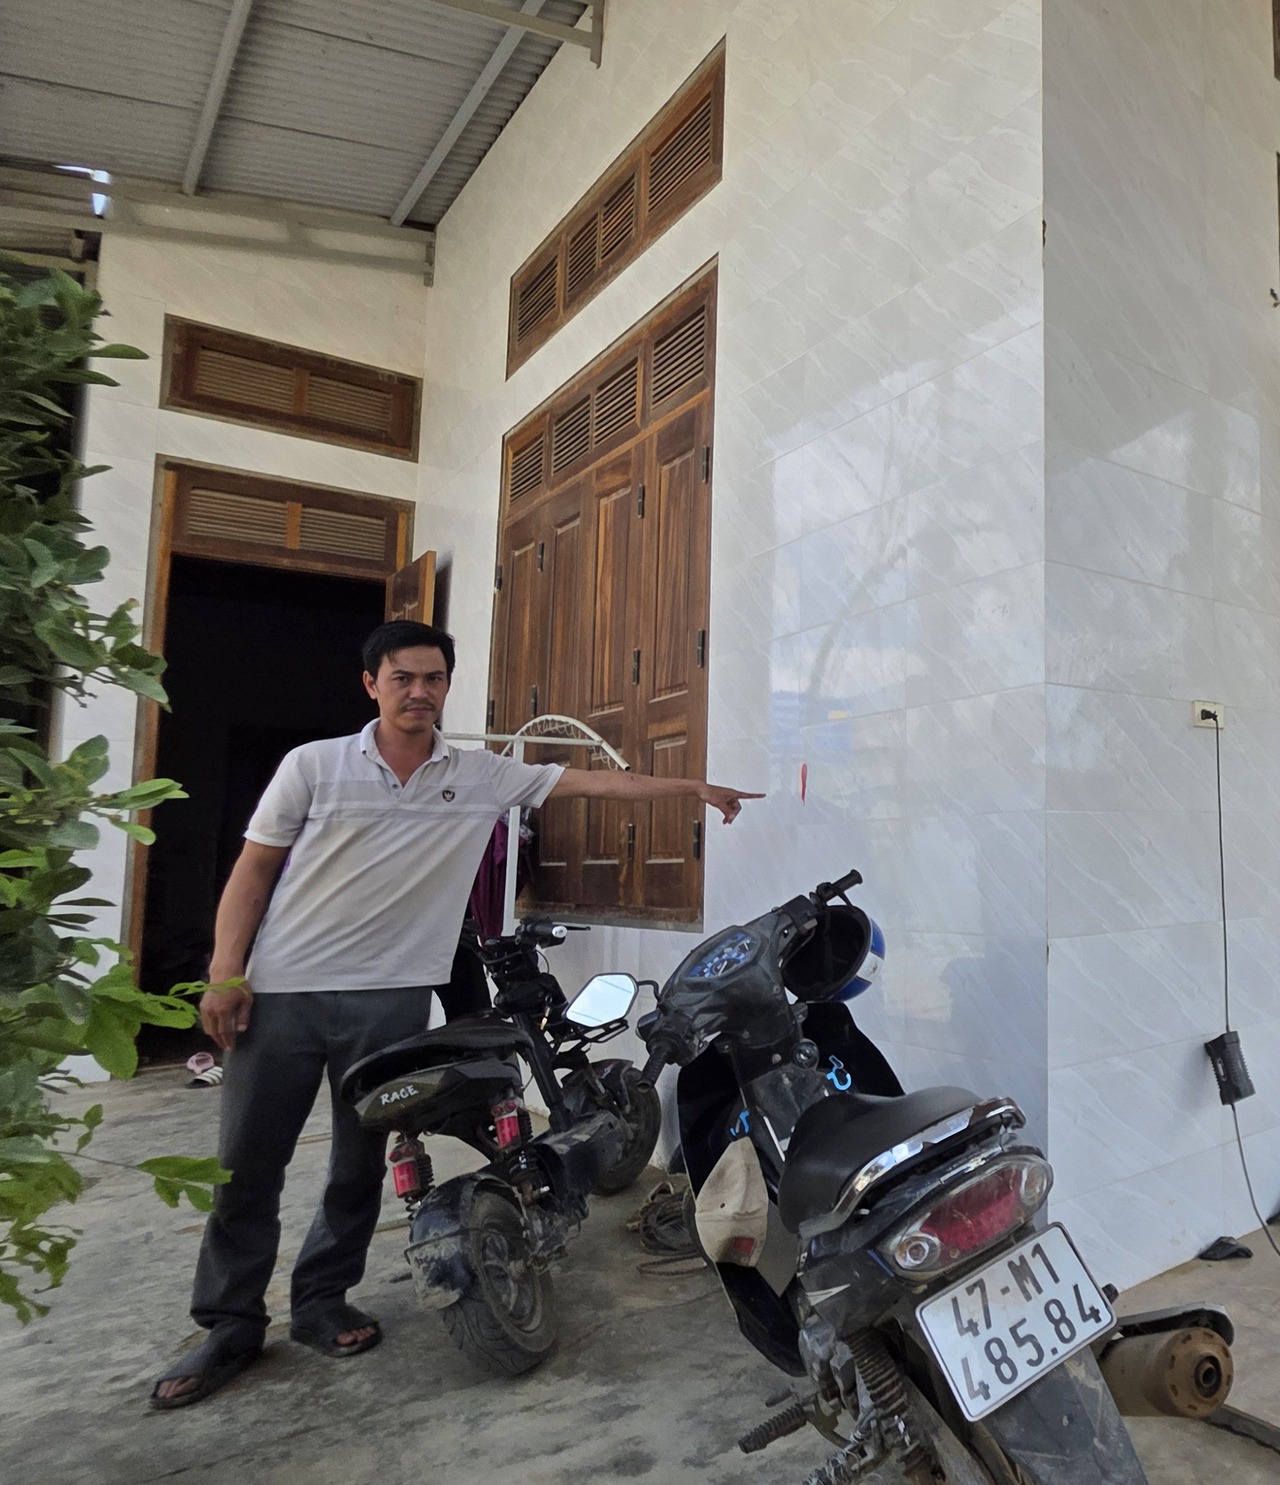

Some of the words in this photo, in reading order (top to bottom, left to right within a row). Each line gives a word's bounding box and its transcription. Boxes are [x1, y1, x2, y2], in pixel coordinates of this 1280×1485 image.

[380, 1085, 419, 1106] RACE
[951, 1242, 1061, 1338] 47-M1
[961, 1283, 1102, 1401] 485.84
